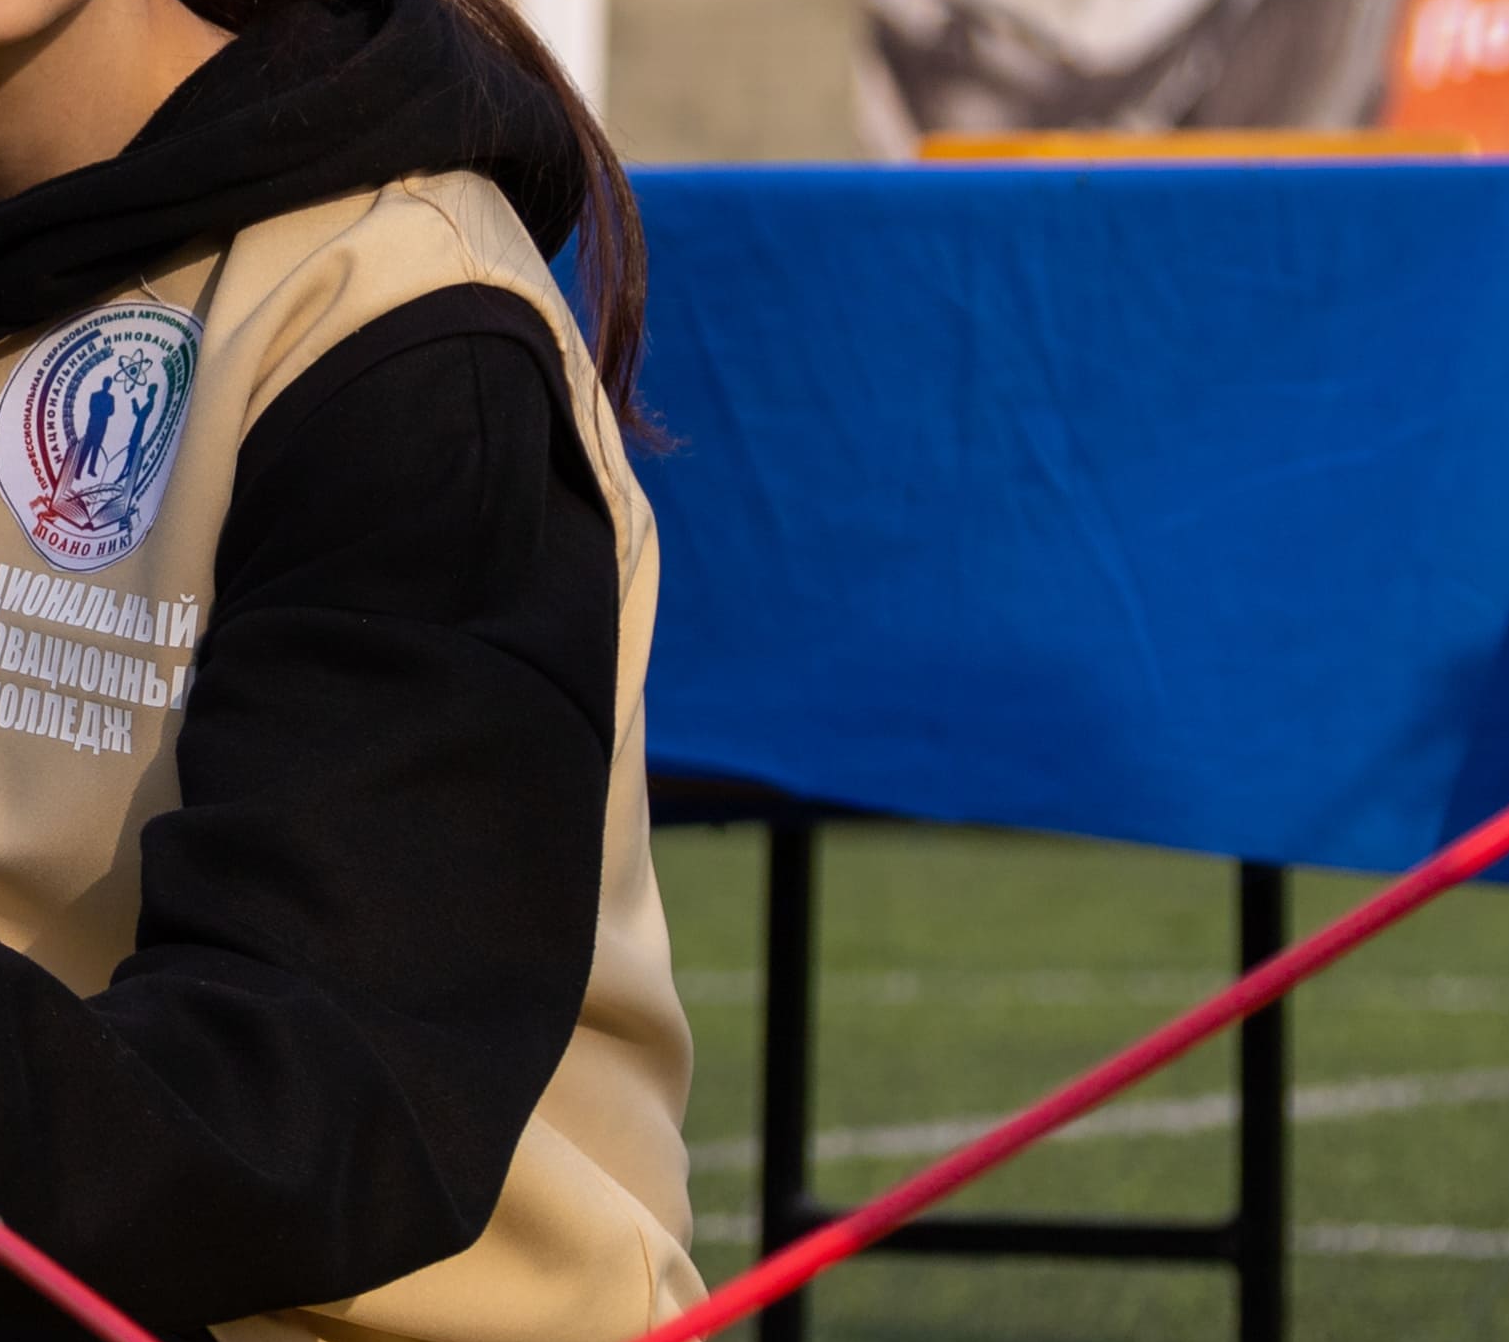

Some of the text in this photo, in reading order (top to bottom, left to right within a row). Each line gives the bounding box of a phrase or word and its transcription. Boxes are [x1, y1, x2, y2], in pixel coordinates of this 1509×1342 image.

[23, 368, 48, 490] ПРОФЕССИОНАЛЬНАЯ
[42, 310, 135, 367] ОБРАЗОВАТЕЛЬНАЯ
[46, 342, 97, 464] НАЦИОНАЛЬНЫЙ
